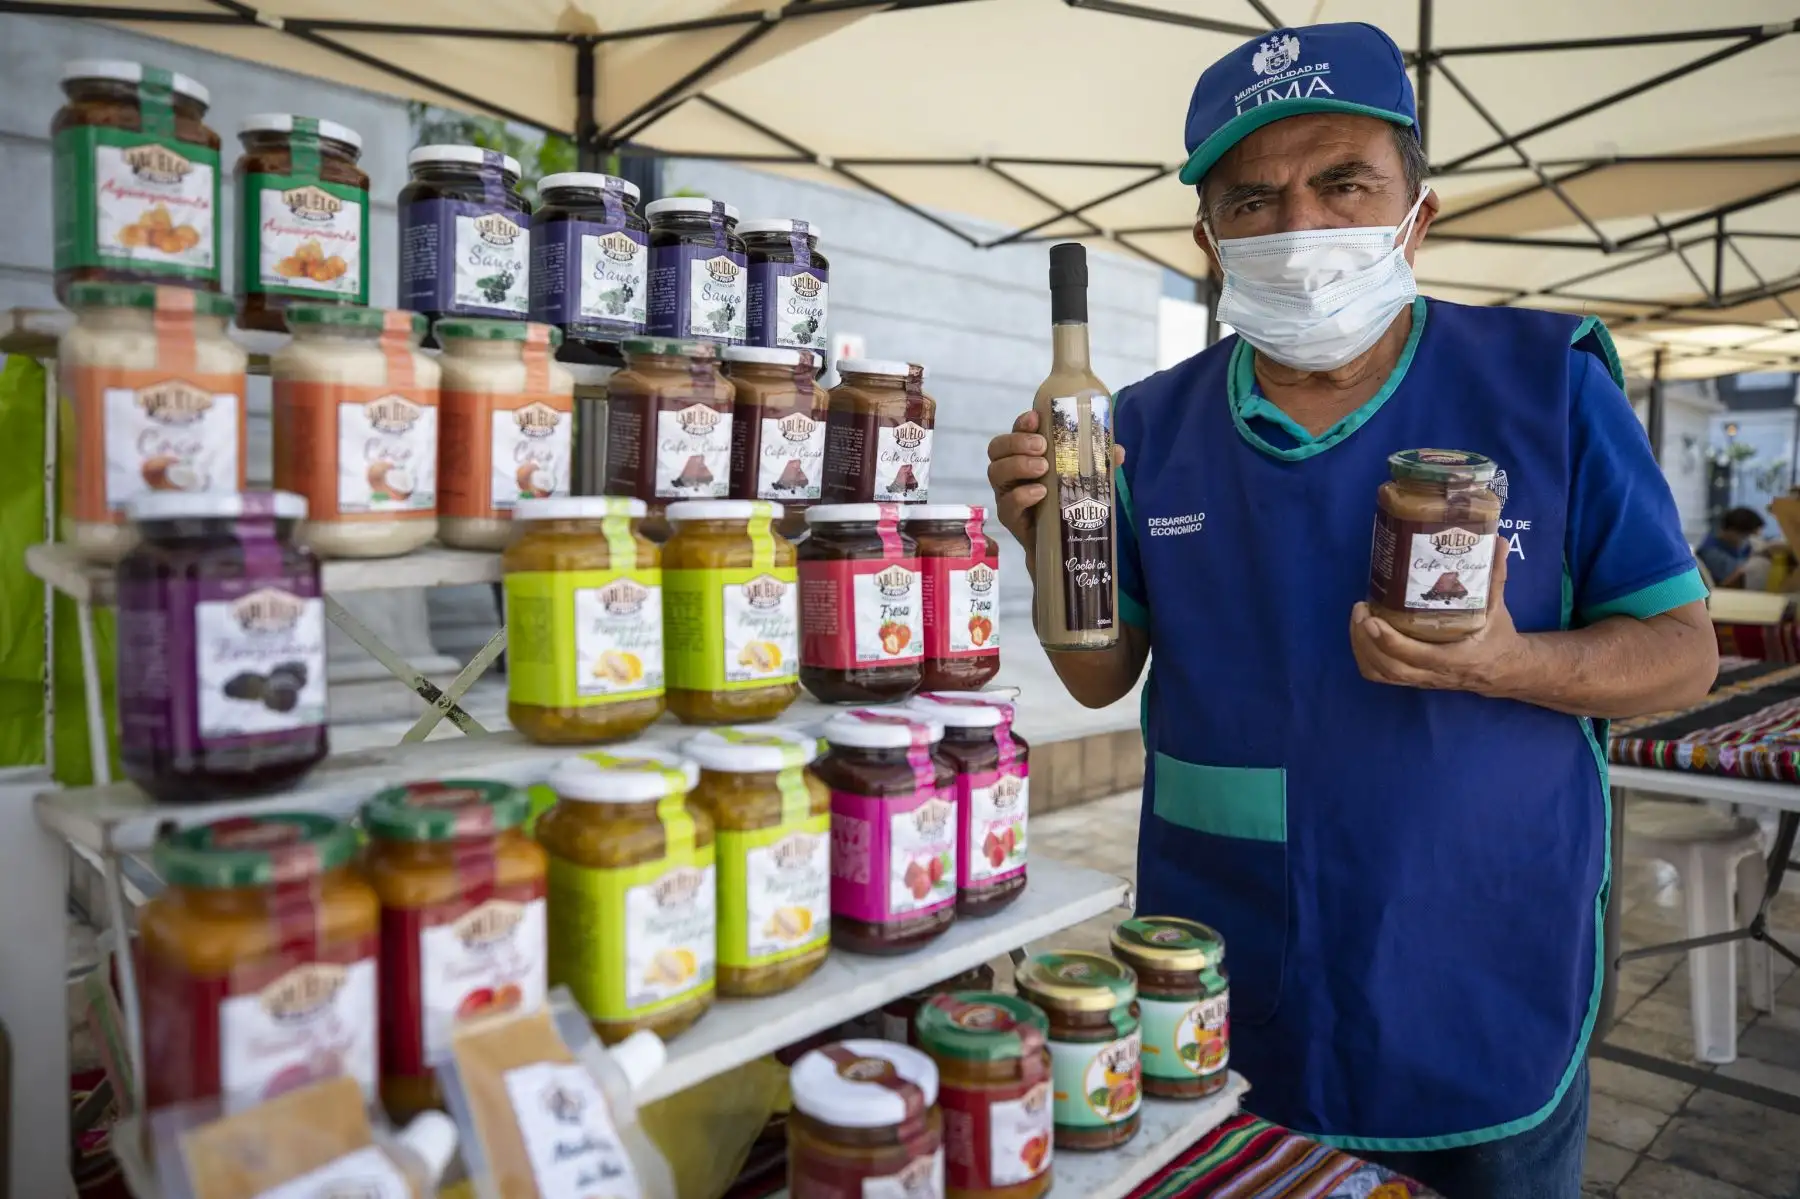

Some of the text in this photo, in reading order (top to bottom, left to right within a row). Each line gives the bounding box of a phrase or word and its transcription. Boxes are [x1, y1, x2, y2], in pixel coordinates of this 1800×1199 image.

[1234, 62, 1330, 102] MUNICIPALIDAD DE
[602, 238, 635, 253] ABUELO
[468, 244, 522, 270] Sauco
[594, 260, 640, 284] Sauco
[709, 262, 737, 275] ABUELO
[792, 277, 820, 290] ABUELO
[702, 283, 741, 304] Sauco
[787, 297, 823, 317] Sauco
[782, 419, 813, 433] ABUELO
[896, 427, 924, 440] ABUELO
[1068, 506, 1107, 522] ABUELO
[1148, 512, 1205, 526] DESARROLLO
[1084, 520, 1103, 529] FRUTA
[1150, 522, 1202, 536] ECONOMICO
[1516, 520, 1532, 530] DE
[1434, 534, 1477, 548] ABUELO
[1065, 557, 1106, 572] Coctel de
[878, 572, 912, 587] ABUELO
[880, 604, 909, 619] Fresa
[969, 599, 991, 612] Fresa
